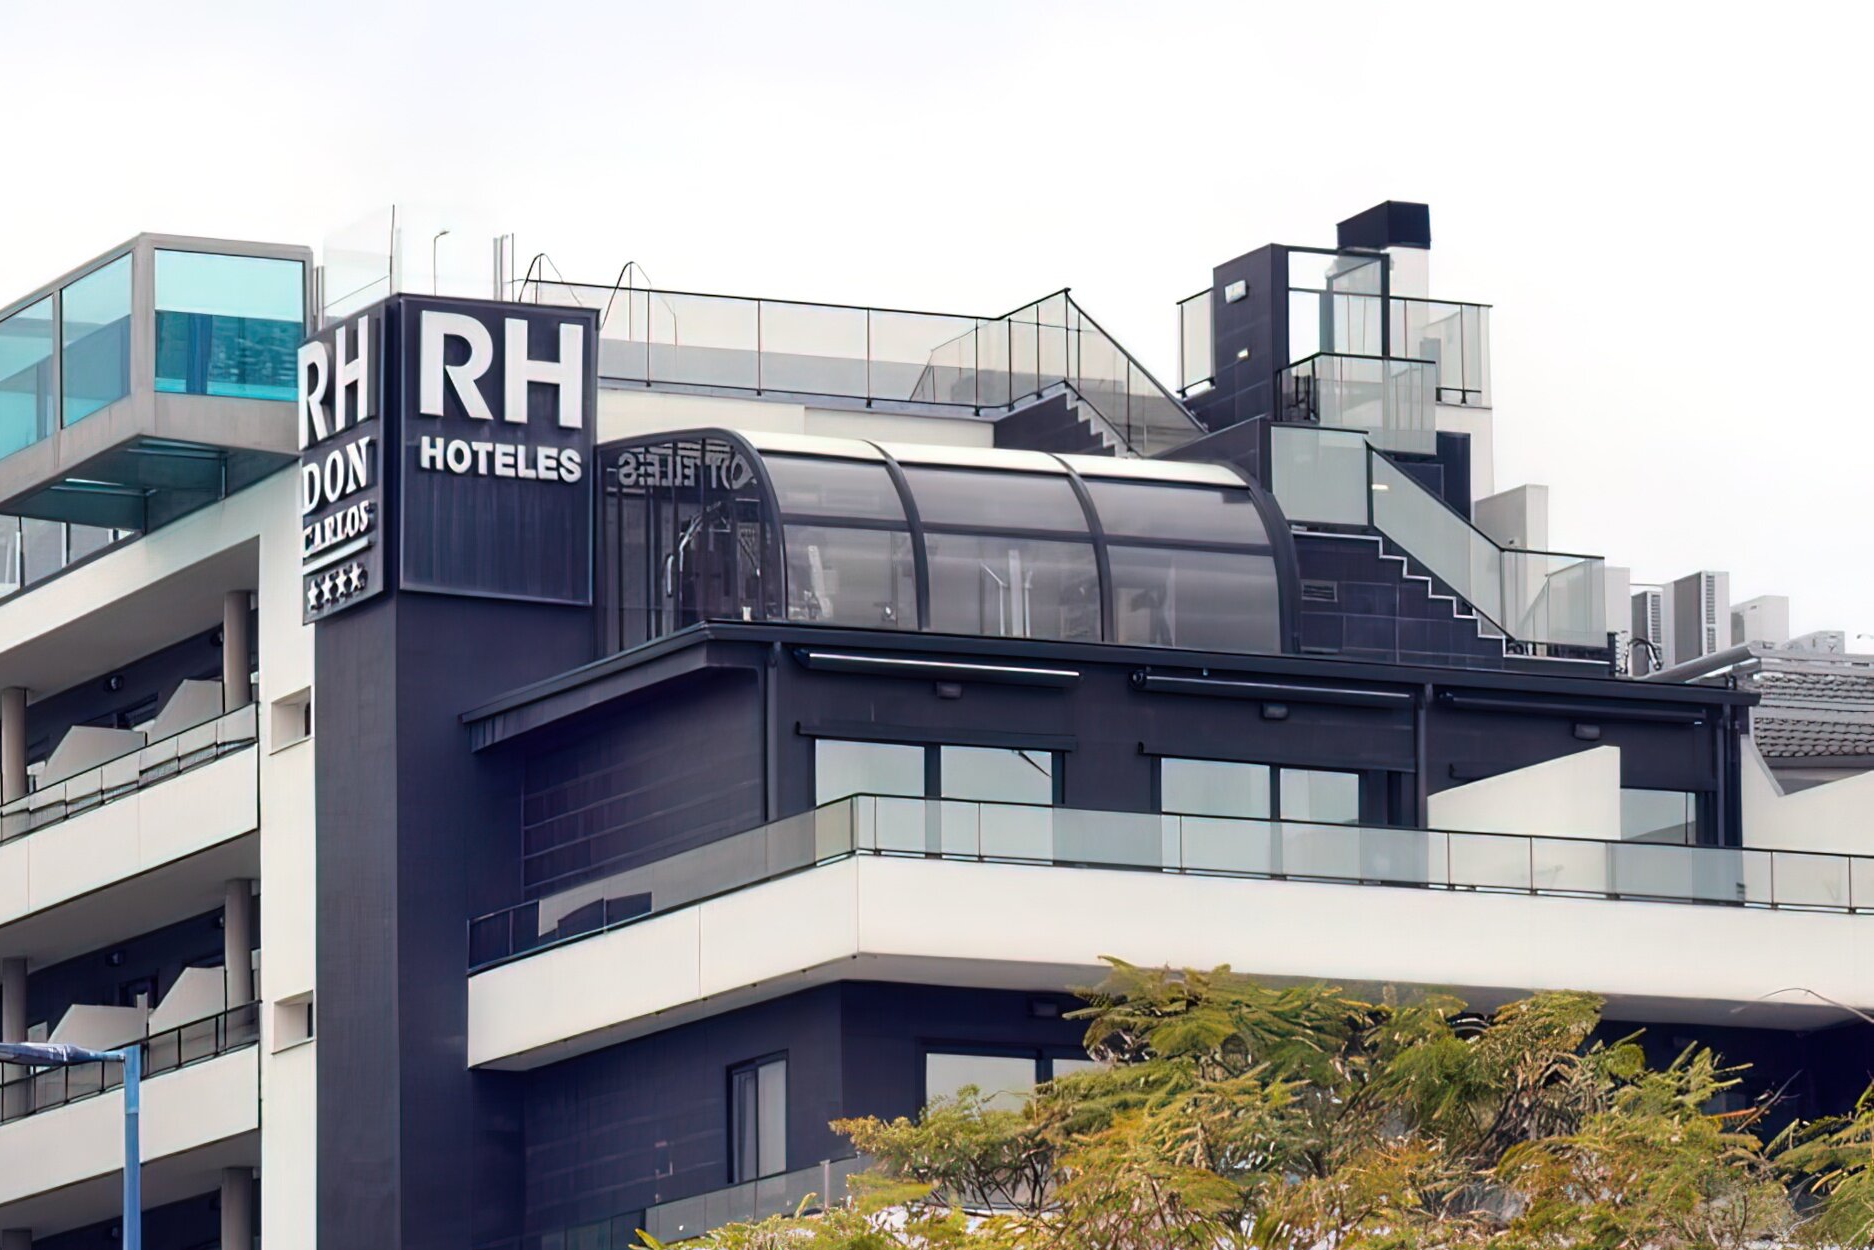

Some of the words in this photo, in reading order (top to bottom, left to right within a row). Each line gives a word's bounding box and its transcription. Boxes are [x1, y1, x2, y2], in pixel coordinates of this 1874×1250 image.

[298, 315, 369, 450] RH
[420, 310, 584, 429] RH
[302, 436, 371, 516] DON
[421, 437, 582, 483] HOTELES
[302, 500, 370, 558] CARLOS
